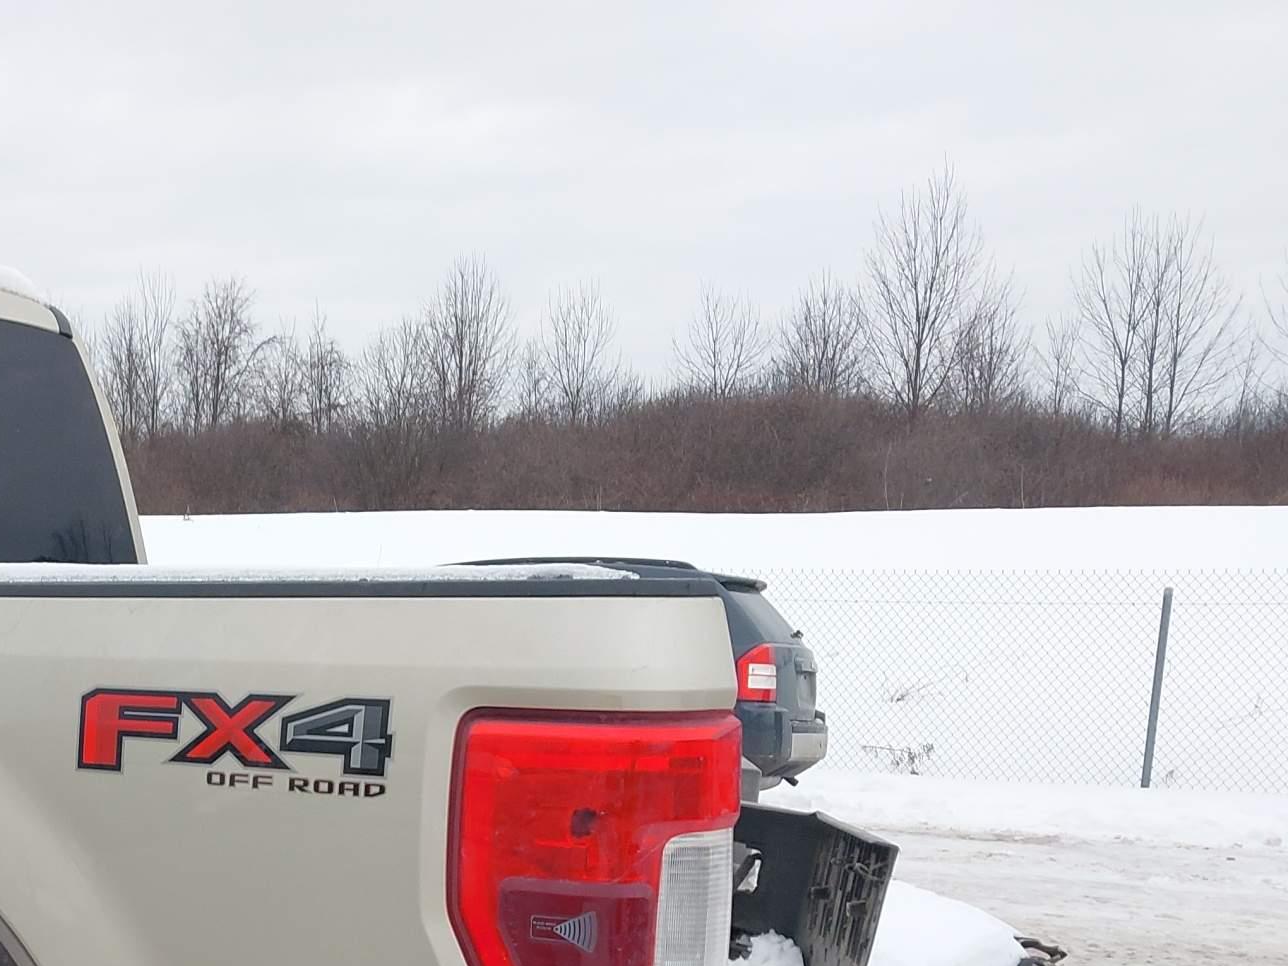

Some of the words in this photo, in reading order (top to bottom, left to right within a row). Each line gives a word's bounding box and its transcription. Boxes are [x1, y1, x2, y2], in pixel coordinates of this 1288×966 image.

[77, 687, 393, 777] FX4
[206, 771, 273, 790] OFF
[288, 777, 387, 798] ROAD
